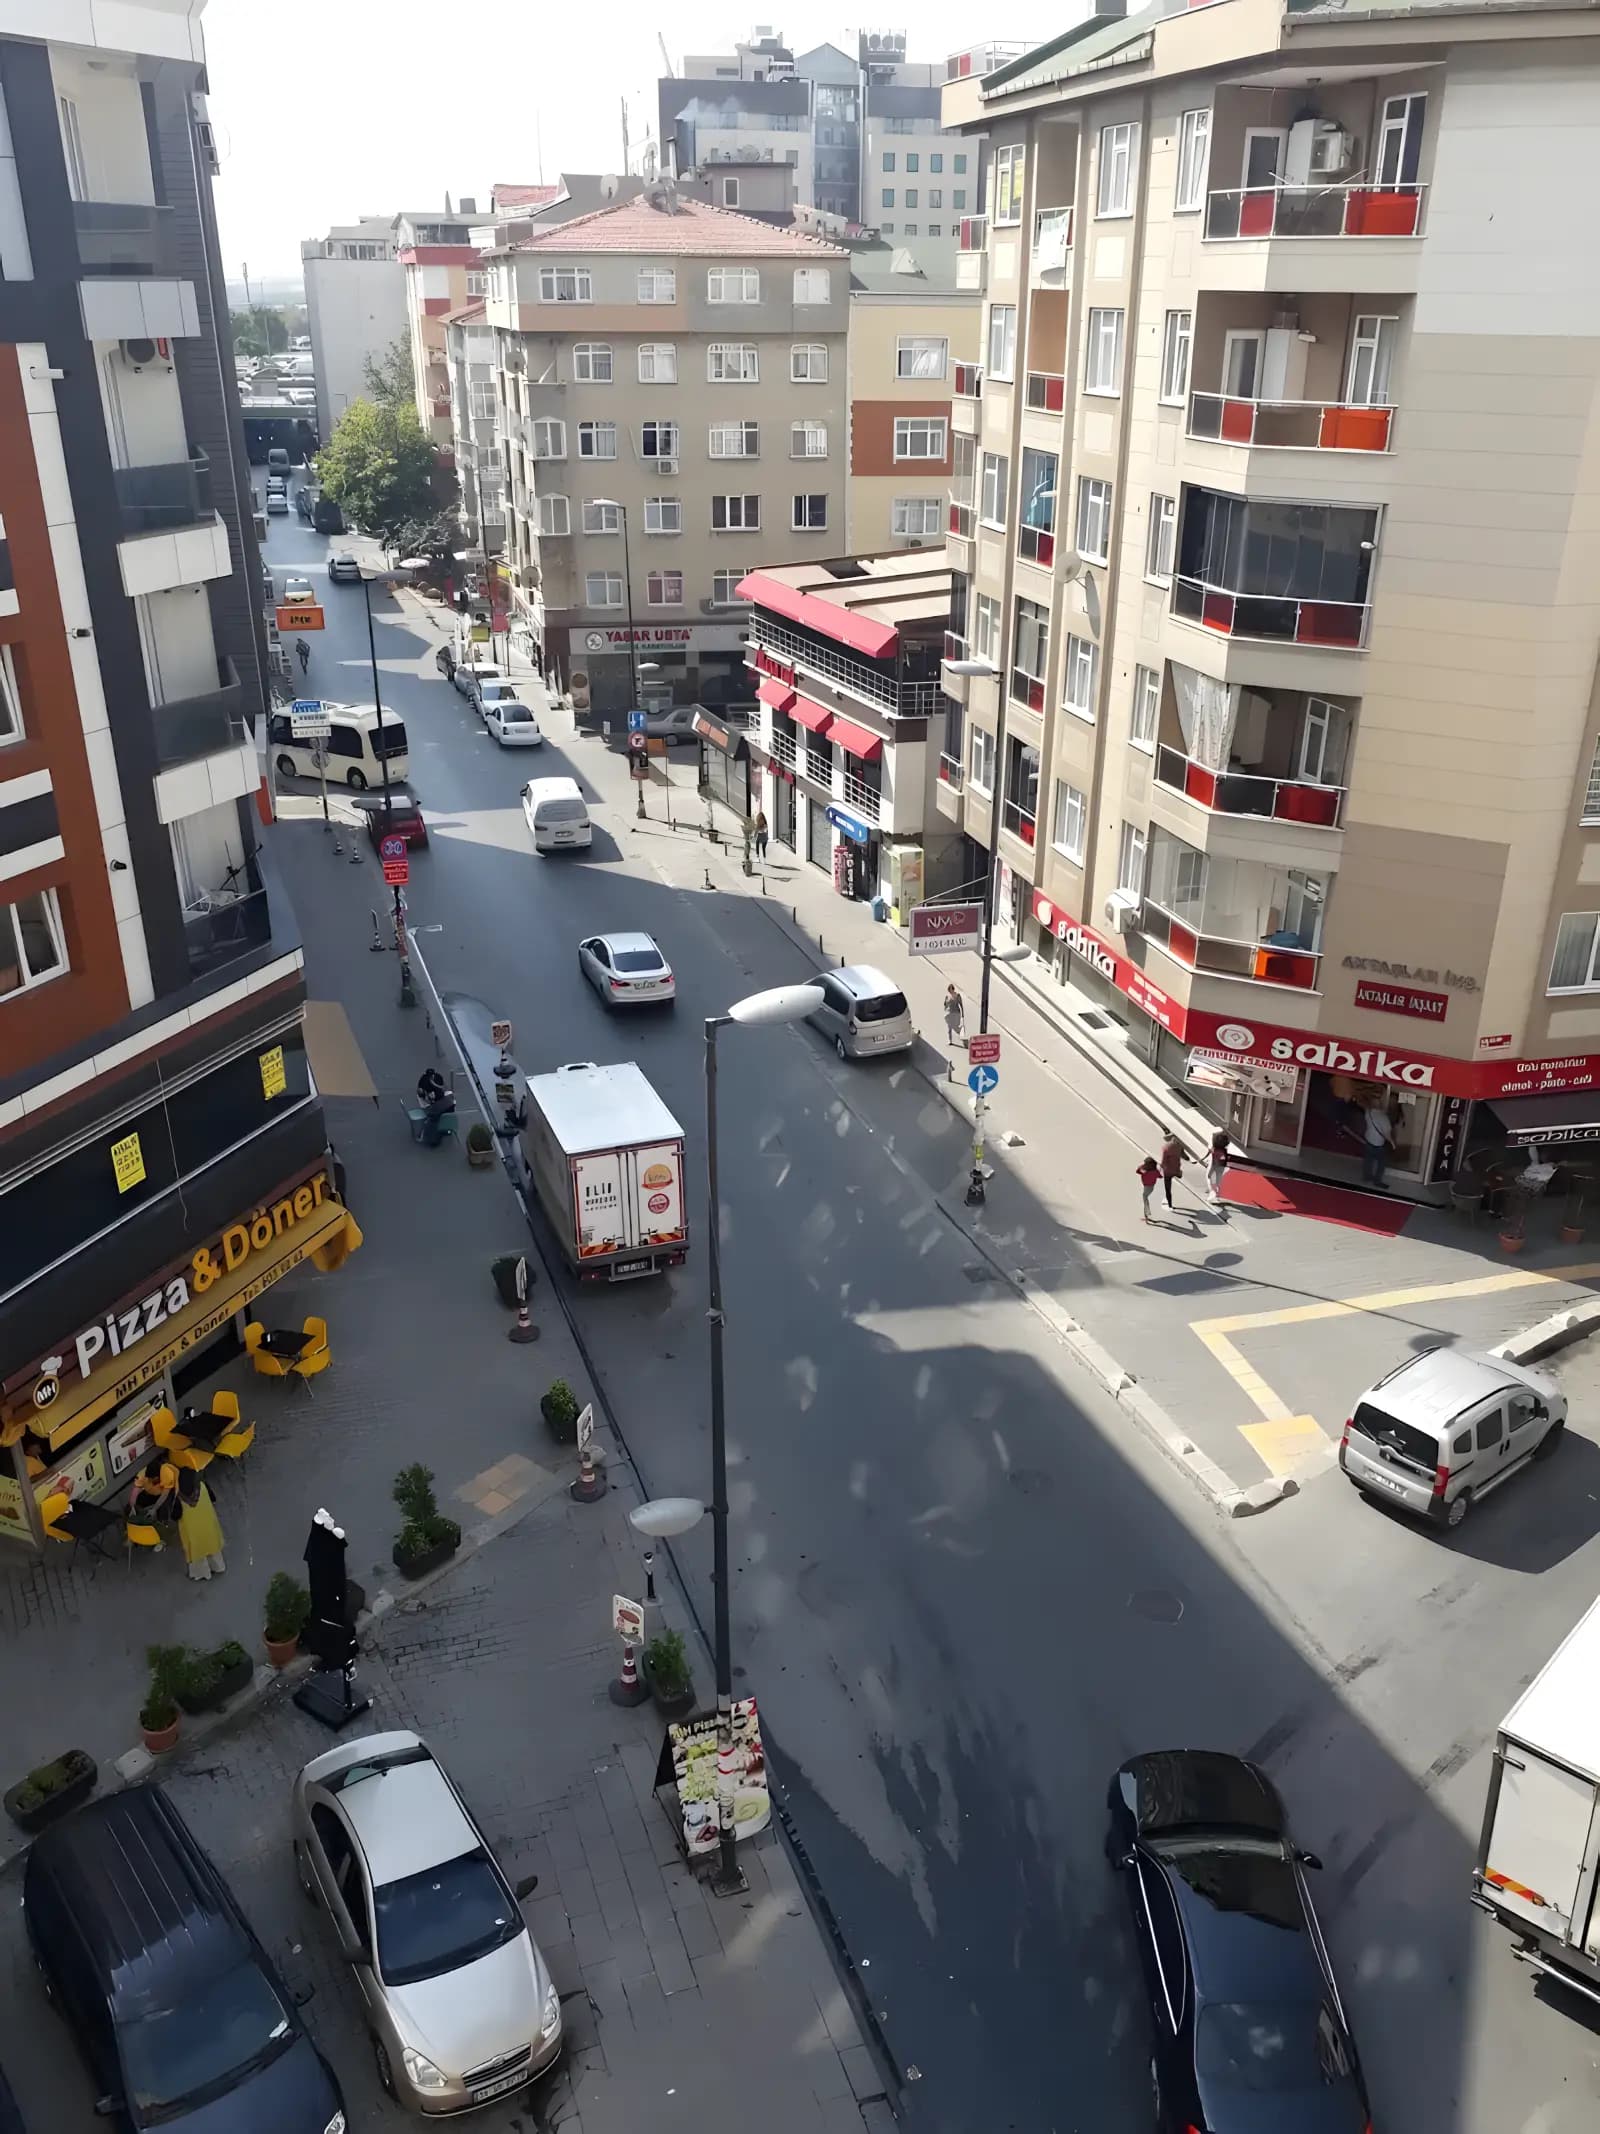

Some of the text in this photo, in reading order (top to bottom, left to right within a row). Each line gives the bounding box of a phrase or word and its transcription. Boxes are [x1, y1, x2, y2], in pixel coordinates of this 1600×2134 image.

[75, 1173, 329, 1379] Pizza & Döner
